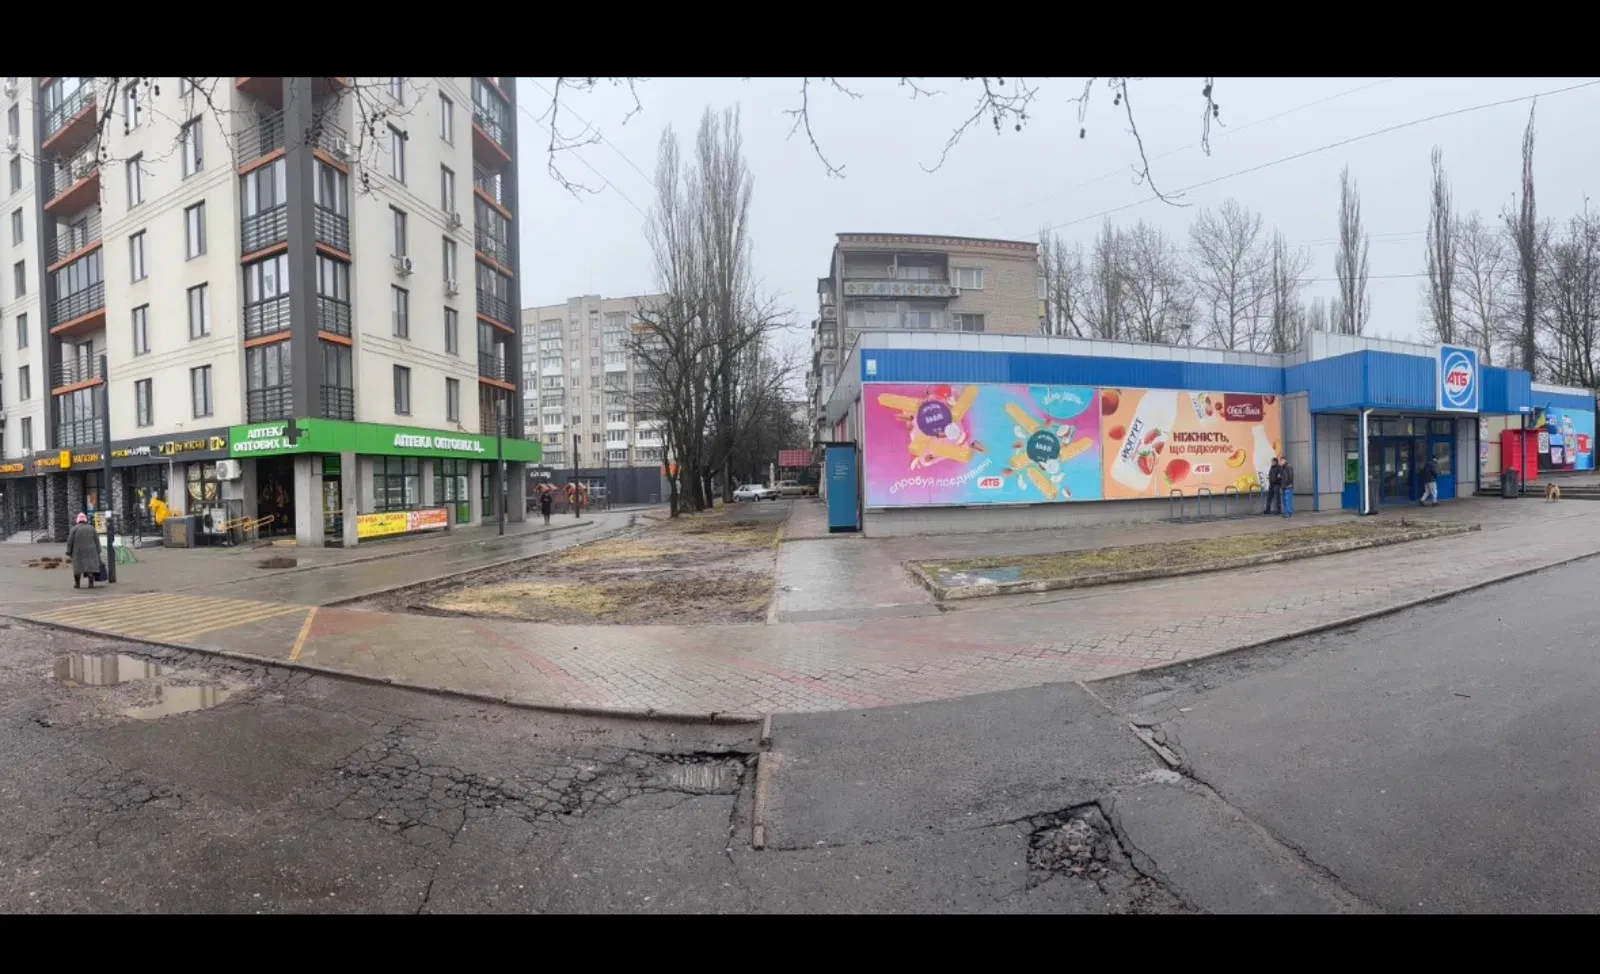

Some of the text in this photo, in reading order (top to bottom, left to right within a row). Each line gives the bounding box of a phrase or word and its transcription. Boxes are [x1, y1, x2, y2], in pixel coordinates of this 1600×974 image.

[1446, 371, 1468, 387] АТБ
[393, 433, 433, 449] АПТЕКА
[434, 436, 473, 452] ОПТОВИХ
[1173, 431, 1230, 443] НІЖНІСТЬ,
[233, 438, 281, 452] ОПТОВИХ
[1169, 445, 1186, 456] ЩО
[1195, 464, 1210, 473] АТБ
[889, 475, 935, 494] спробуй
[980, 477, 1001, 487] АТБ
